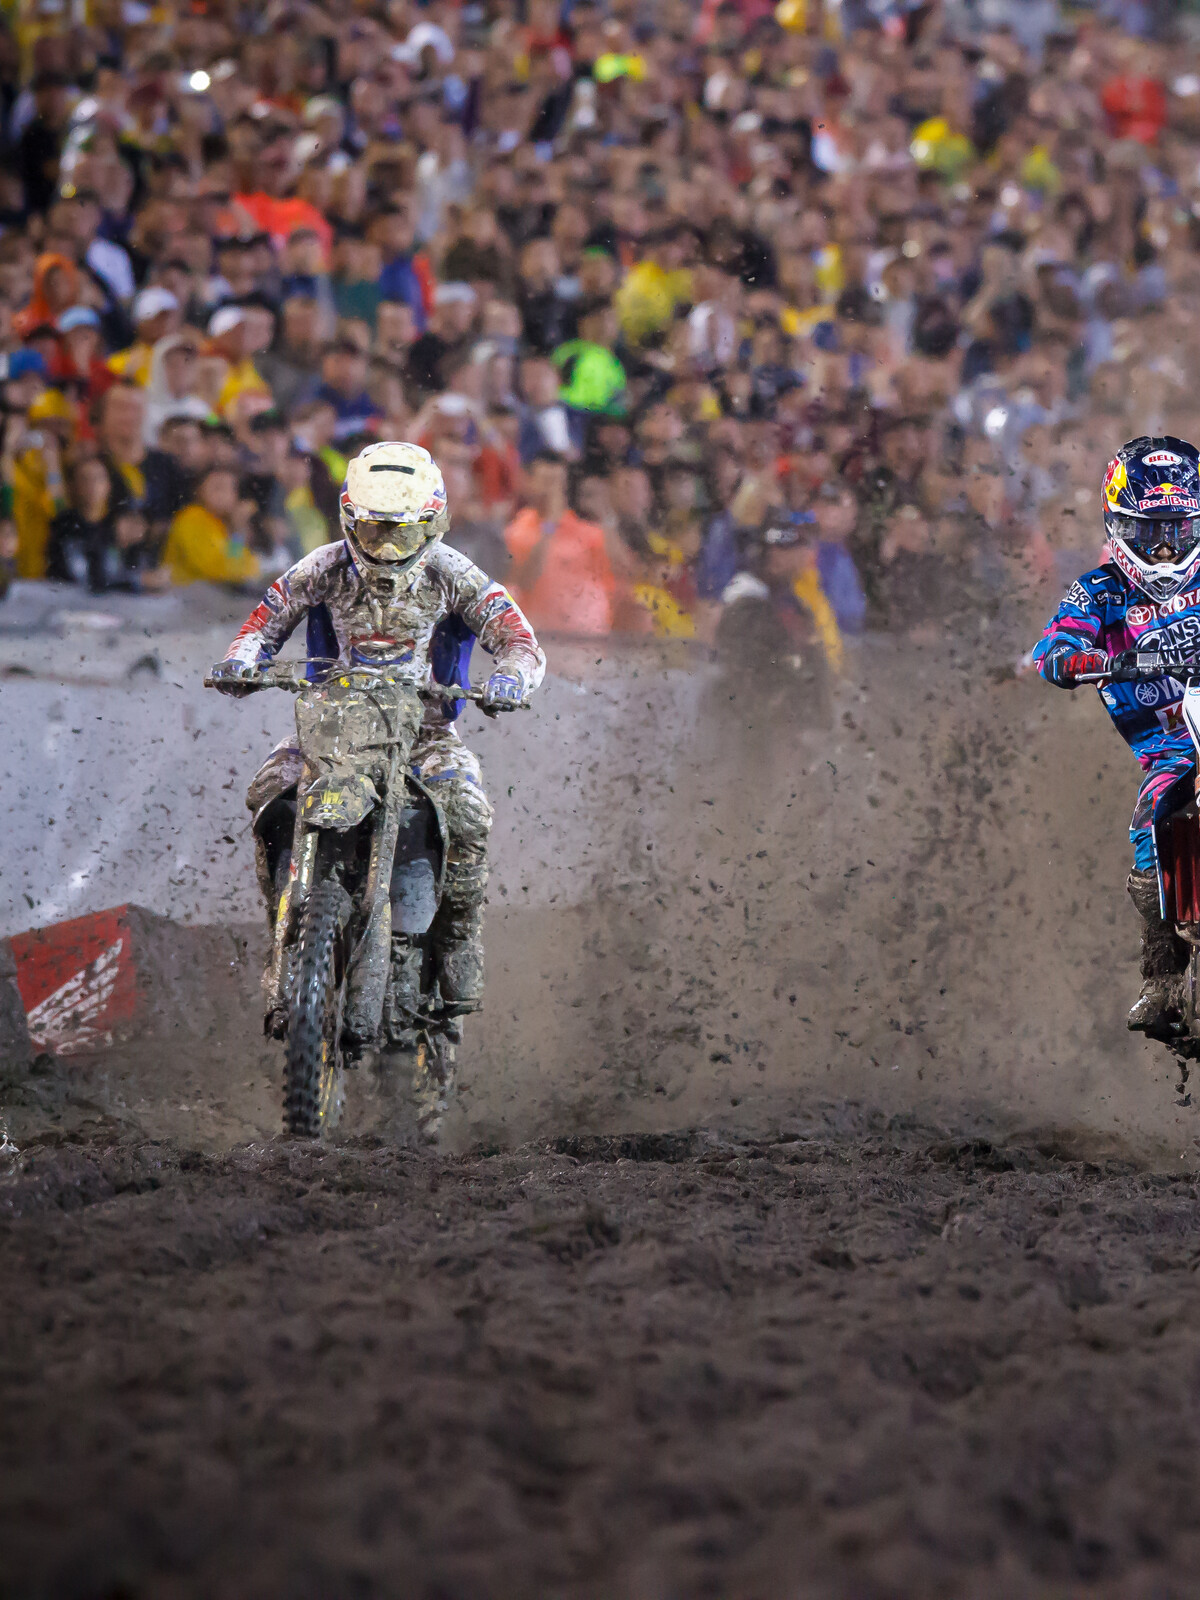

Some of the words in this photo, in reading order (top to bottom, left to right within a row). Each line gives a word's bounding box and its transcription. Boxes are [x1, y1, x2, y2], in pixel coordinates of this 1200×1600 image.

[1148, 454, 1177, 463] BELL
[1139, 496, 1168, 510] Red
[1170, 496, 1199, 510] Bull
